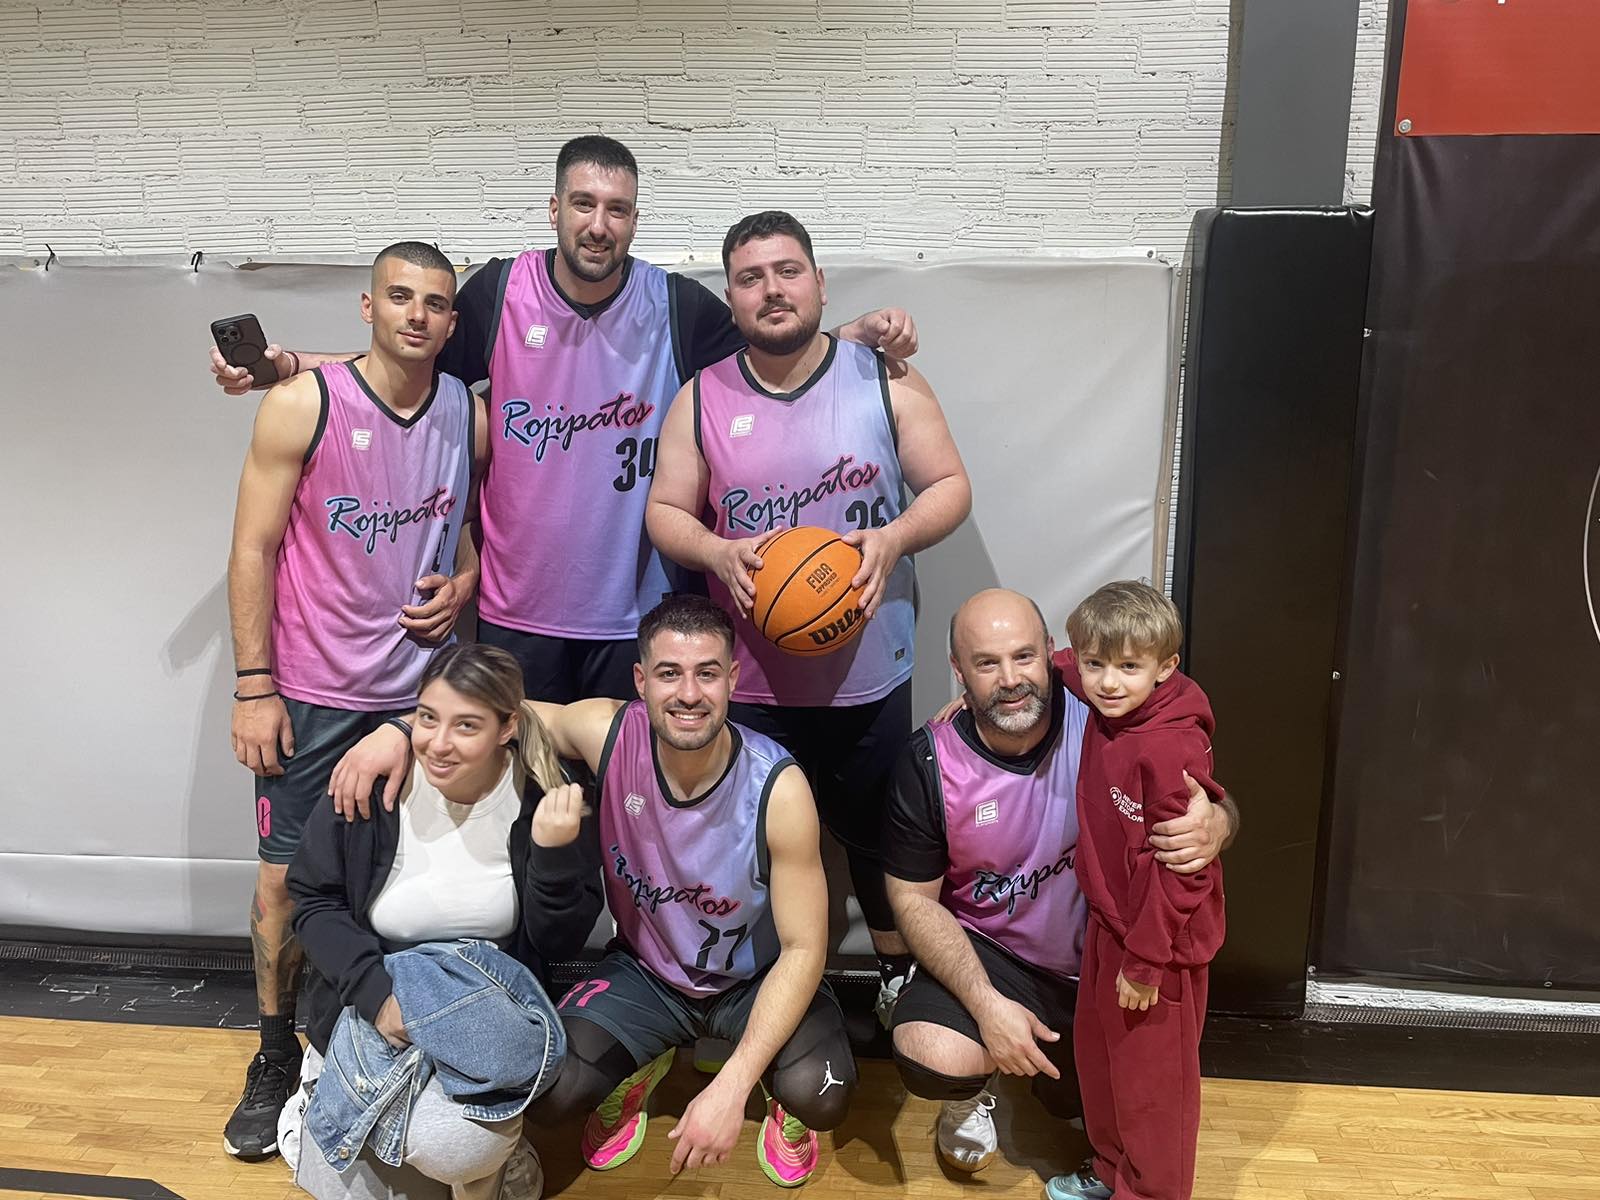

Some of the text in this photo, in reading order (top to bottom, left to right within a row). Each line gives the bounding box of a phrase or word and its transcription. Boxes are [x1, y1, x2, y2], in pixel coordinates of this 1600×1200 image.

[502, 393, 653, 463] Rojipatos
[721, 456, 879, 532] Rojipatos
[806, 562, 833, 590] FIBA
[808, 607, 864, 645] Wils
[1118, 804, 1144, 823] EXPLOR
[1120, 799, 1135, 813] STOP
[1122, 794, 1143, 810] NEVER
[974, 844, 1076, 915] Rojipa
